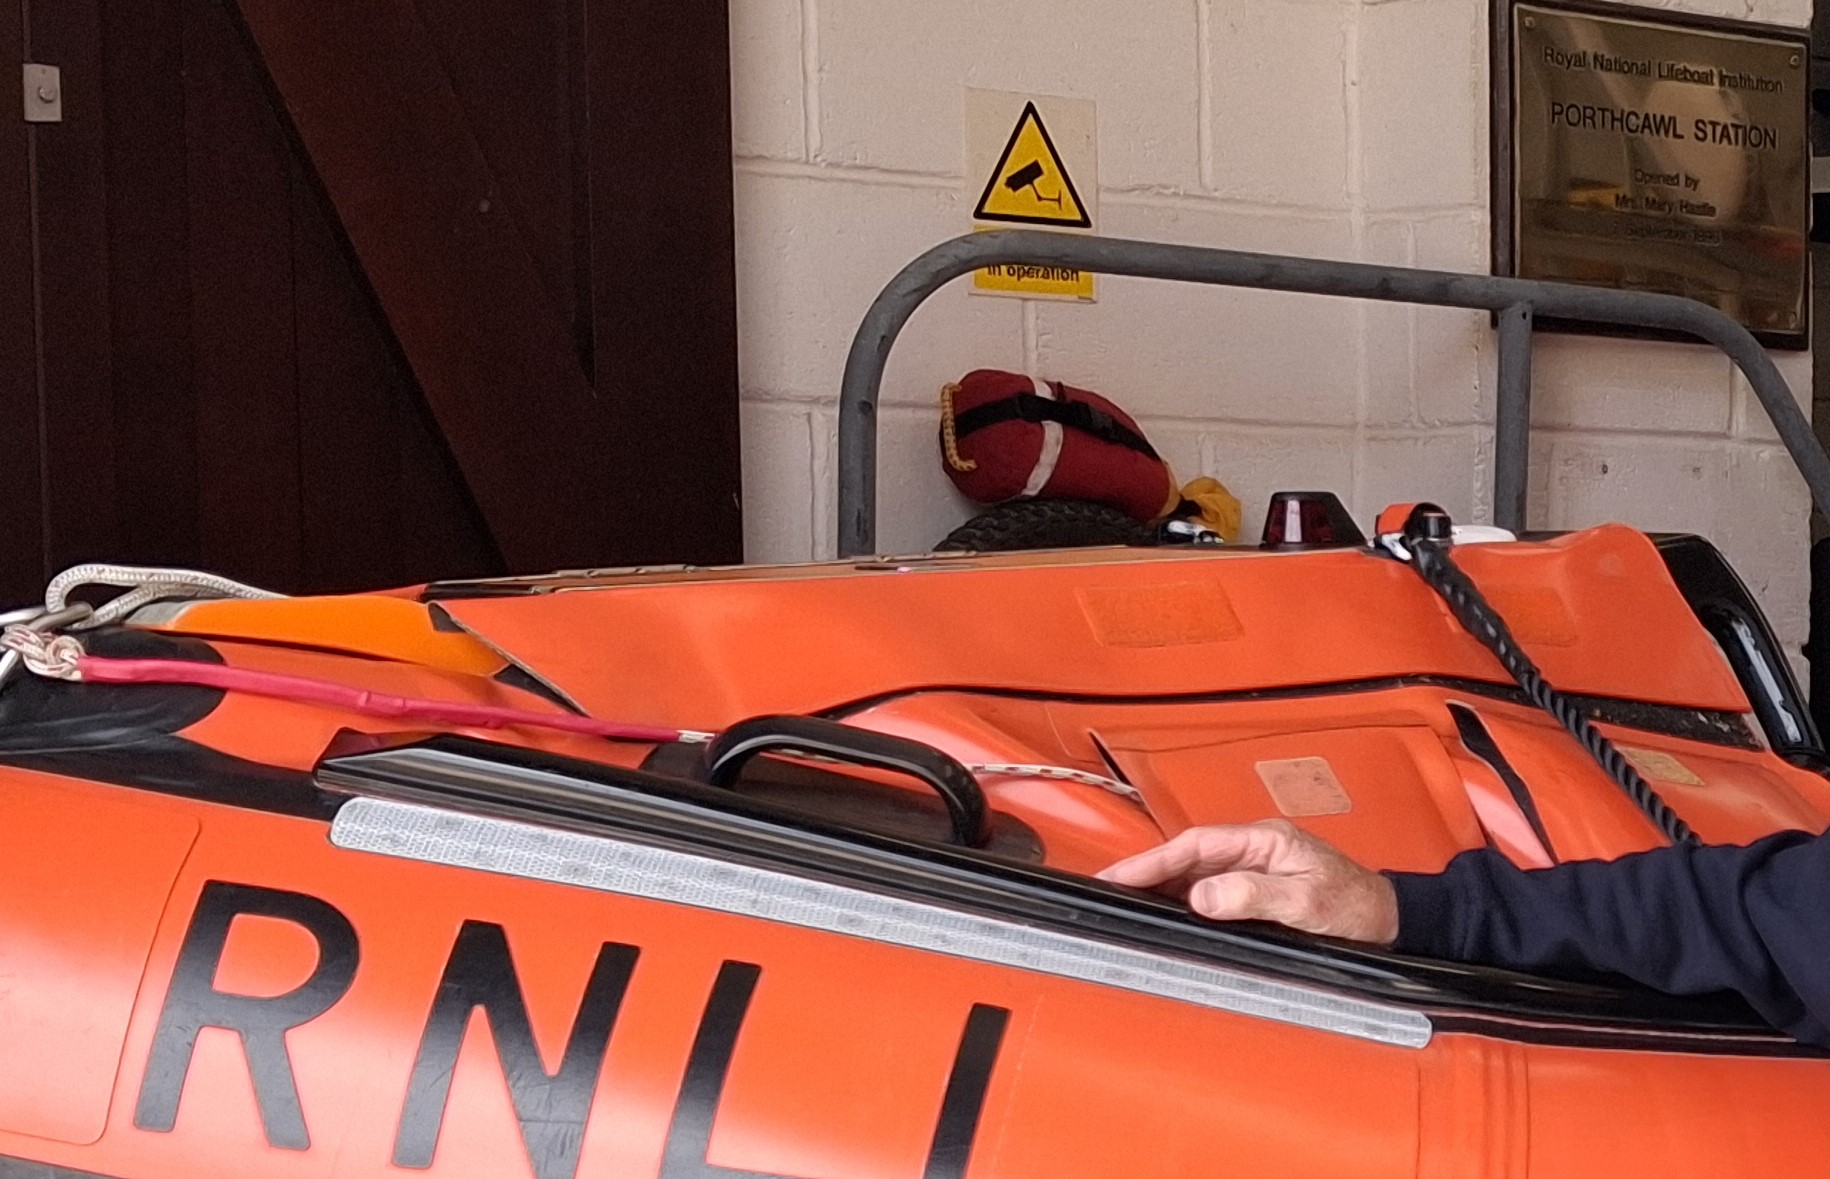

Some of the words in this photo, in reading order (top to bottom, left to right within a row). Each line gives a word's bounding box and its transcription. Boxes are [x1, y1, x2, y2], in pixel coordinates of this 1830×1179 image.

[1544, 46, 1587, 71] Royal
[1593, 51, 1651, 75] National
[1658, 62, 1716, 86] Lifeboat
[1719, 70, 1783, 93] Institution
[1551, 102, 1685, 140] PORTHCAWL
[1694, 118, 1778, 150] STATION
